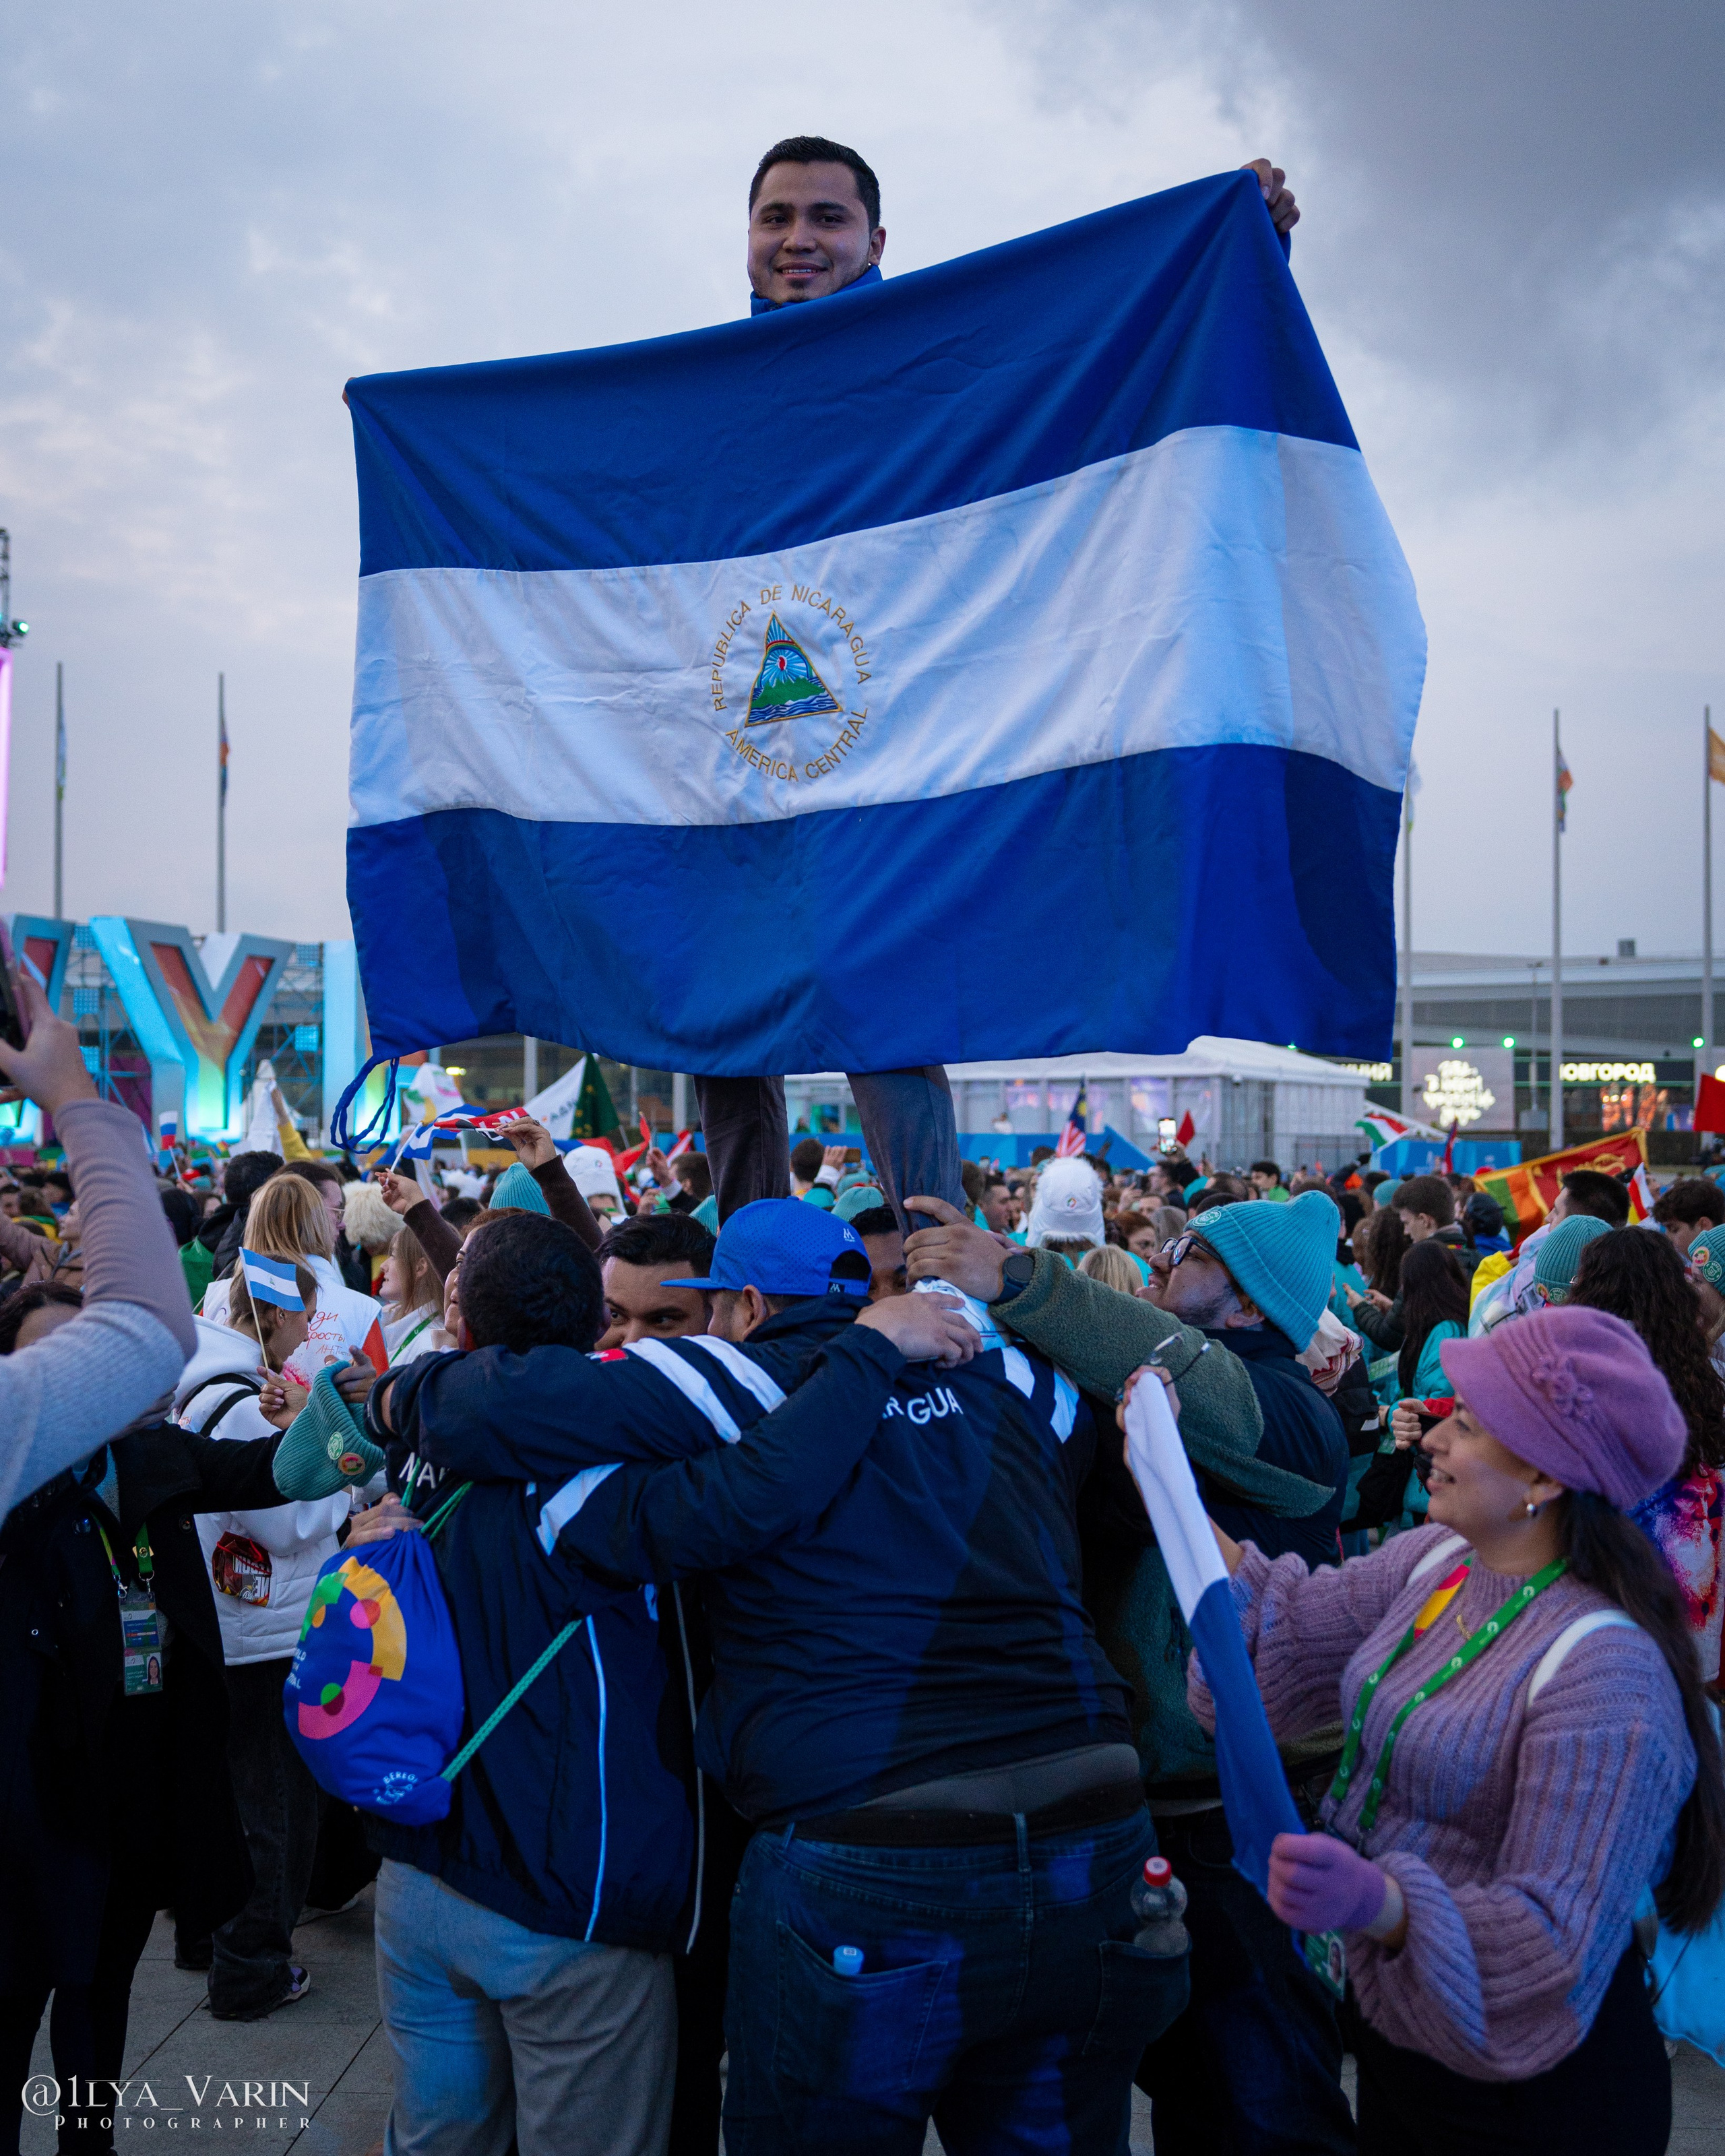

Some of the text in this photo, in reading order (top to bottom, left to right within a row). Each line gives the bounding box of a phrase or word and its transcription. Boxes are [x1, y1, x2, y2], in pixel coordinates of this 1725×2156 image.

[711, 583, 871, 711] REPUBLICA DE NICARAGUA
[725, 707, 868, 782] AMERICA CENTRAL
[306, 1331, 346, 1350] росты
[309, 1311, 339, 1331] ди
